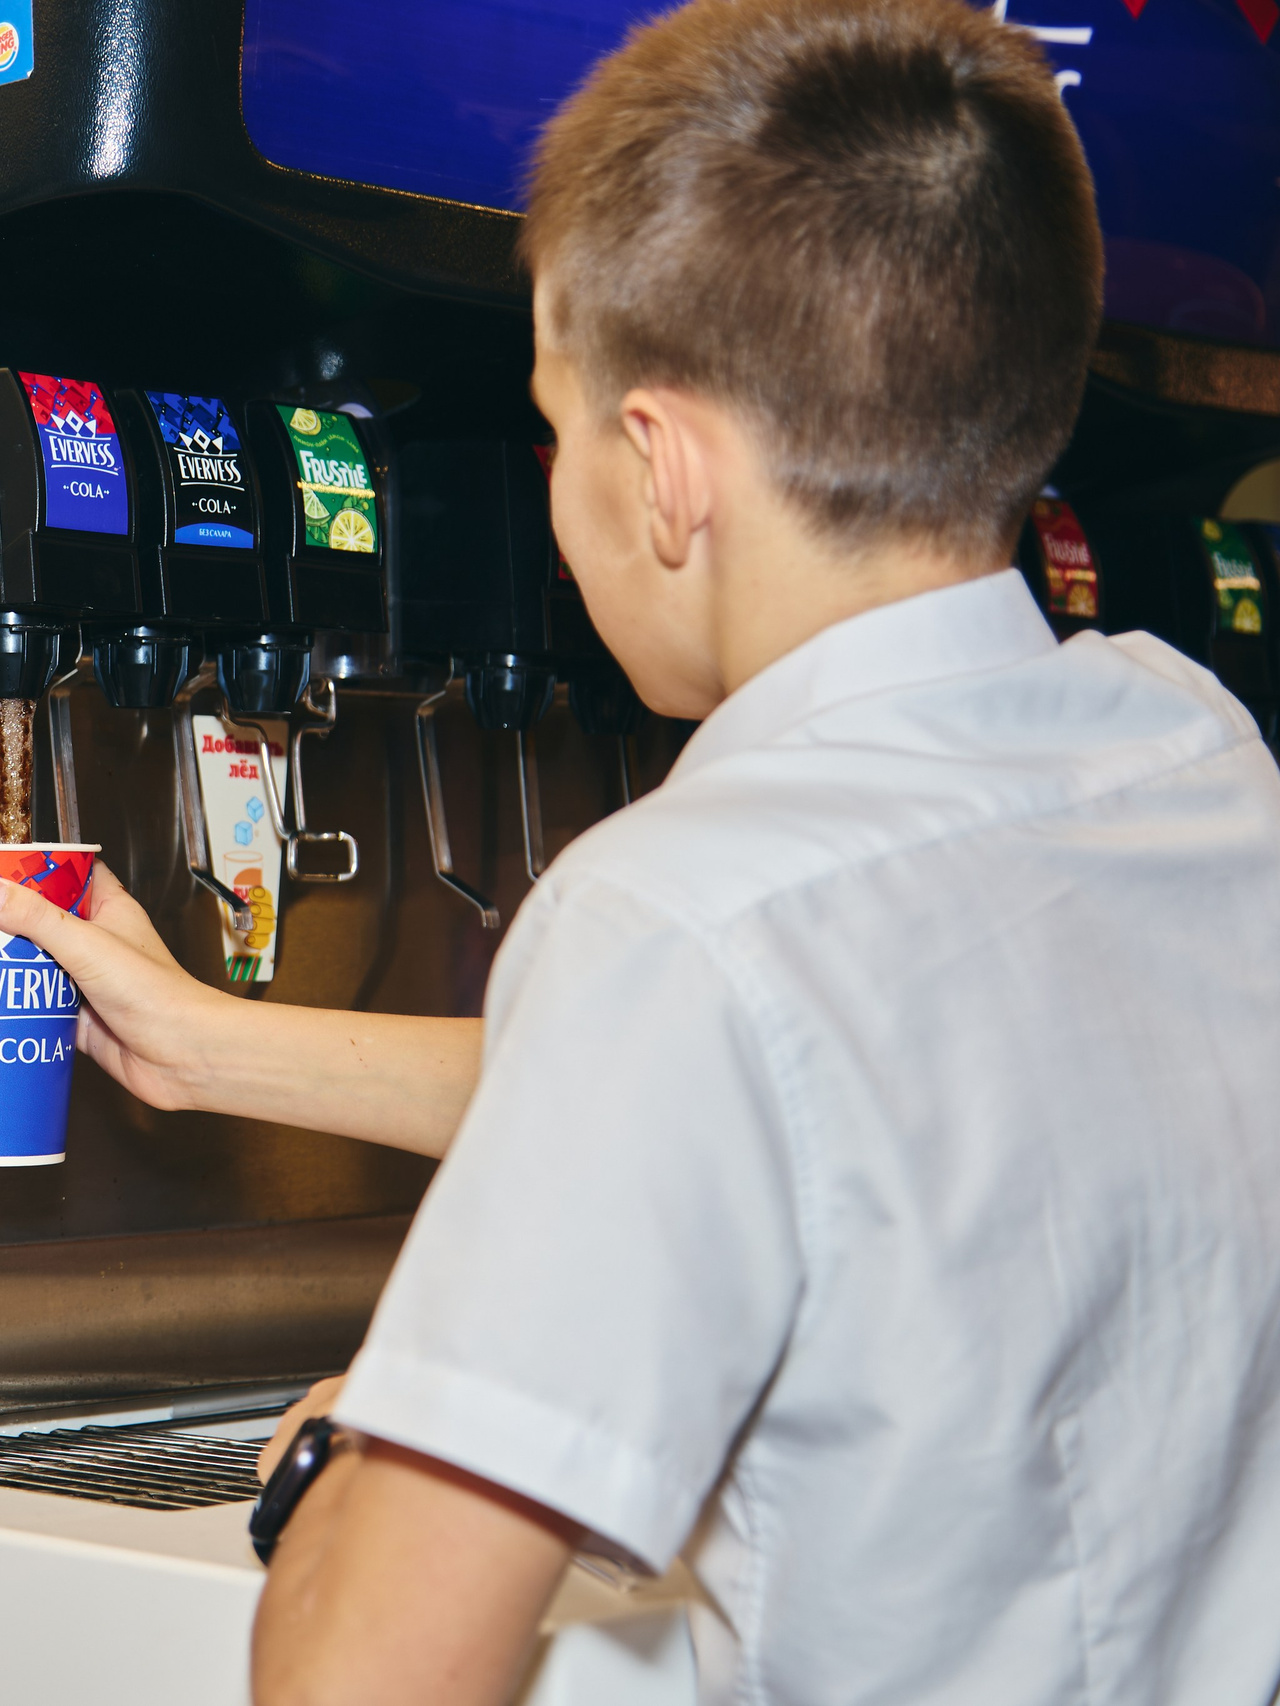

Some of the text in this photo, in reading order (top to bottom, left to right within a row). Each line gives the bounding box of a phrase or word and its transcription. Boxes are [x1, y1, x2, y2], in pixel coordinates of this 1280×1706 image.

[49, 435, 115, 468] EVERVESS
[177, 454, 242, 484] EVERVESS
[70, 481, 104, 499] COLA
[198, 498, 231, 515] COLA
[229, 759, 259, 780] лёд
